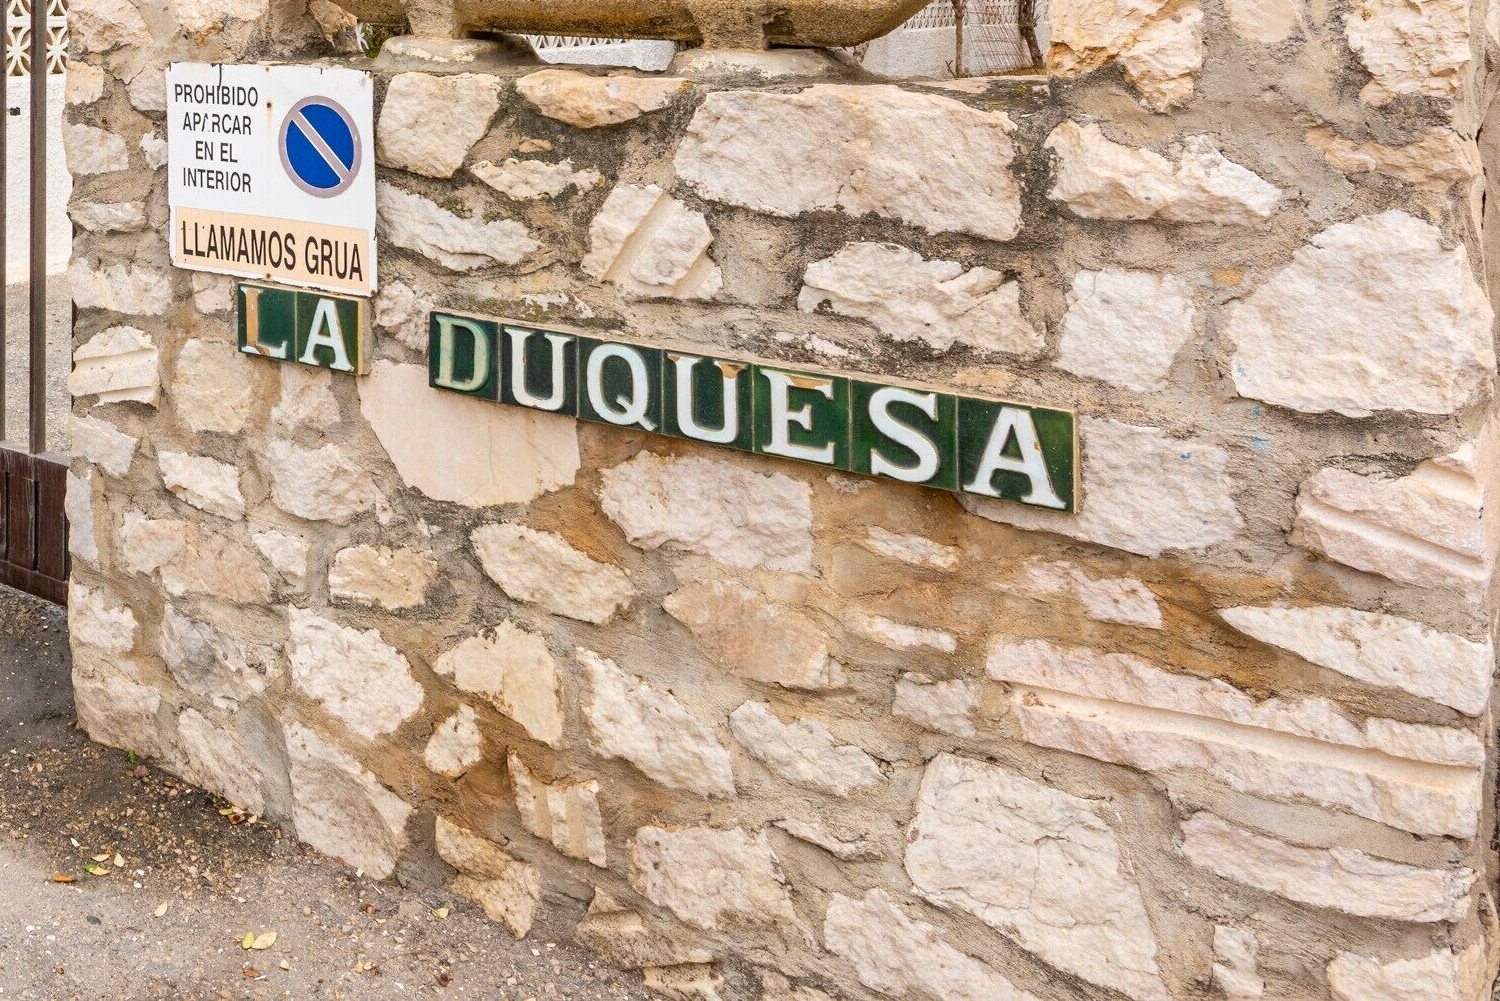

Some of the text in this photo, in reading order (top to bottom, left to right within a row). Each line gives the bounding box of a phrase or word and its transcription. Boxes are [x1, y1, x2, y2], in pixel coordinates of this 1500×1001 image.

[174, 84, 258, 107] PROHIBIDO
[195, 140, 238, 163] EN EL
[183, 167, 251, 193] INTERIOR
[182, 221, 363, 281] LLAMAMOS GRUA
[240, 286, 1067, 509] LA DUQUESA
